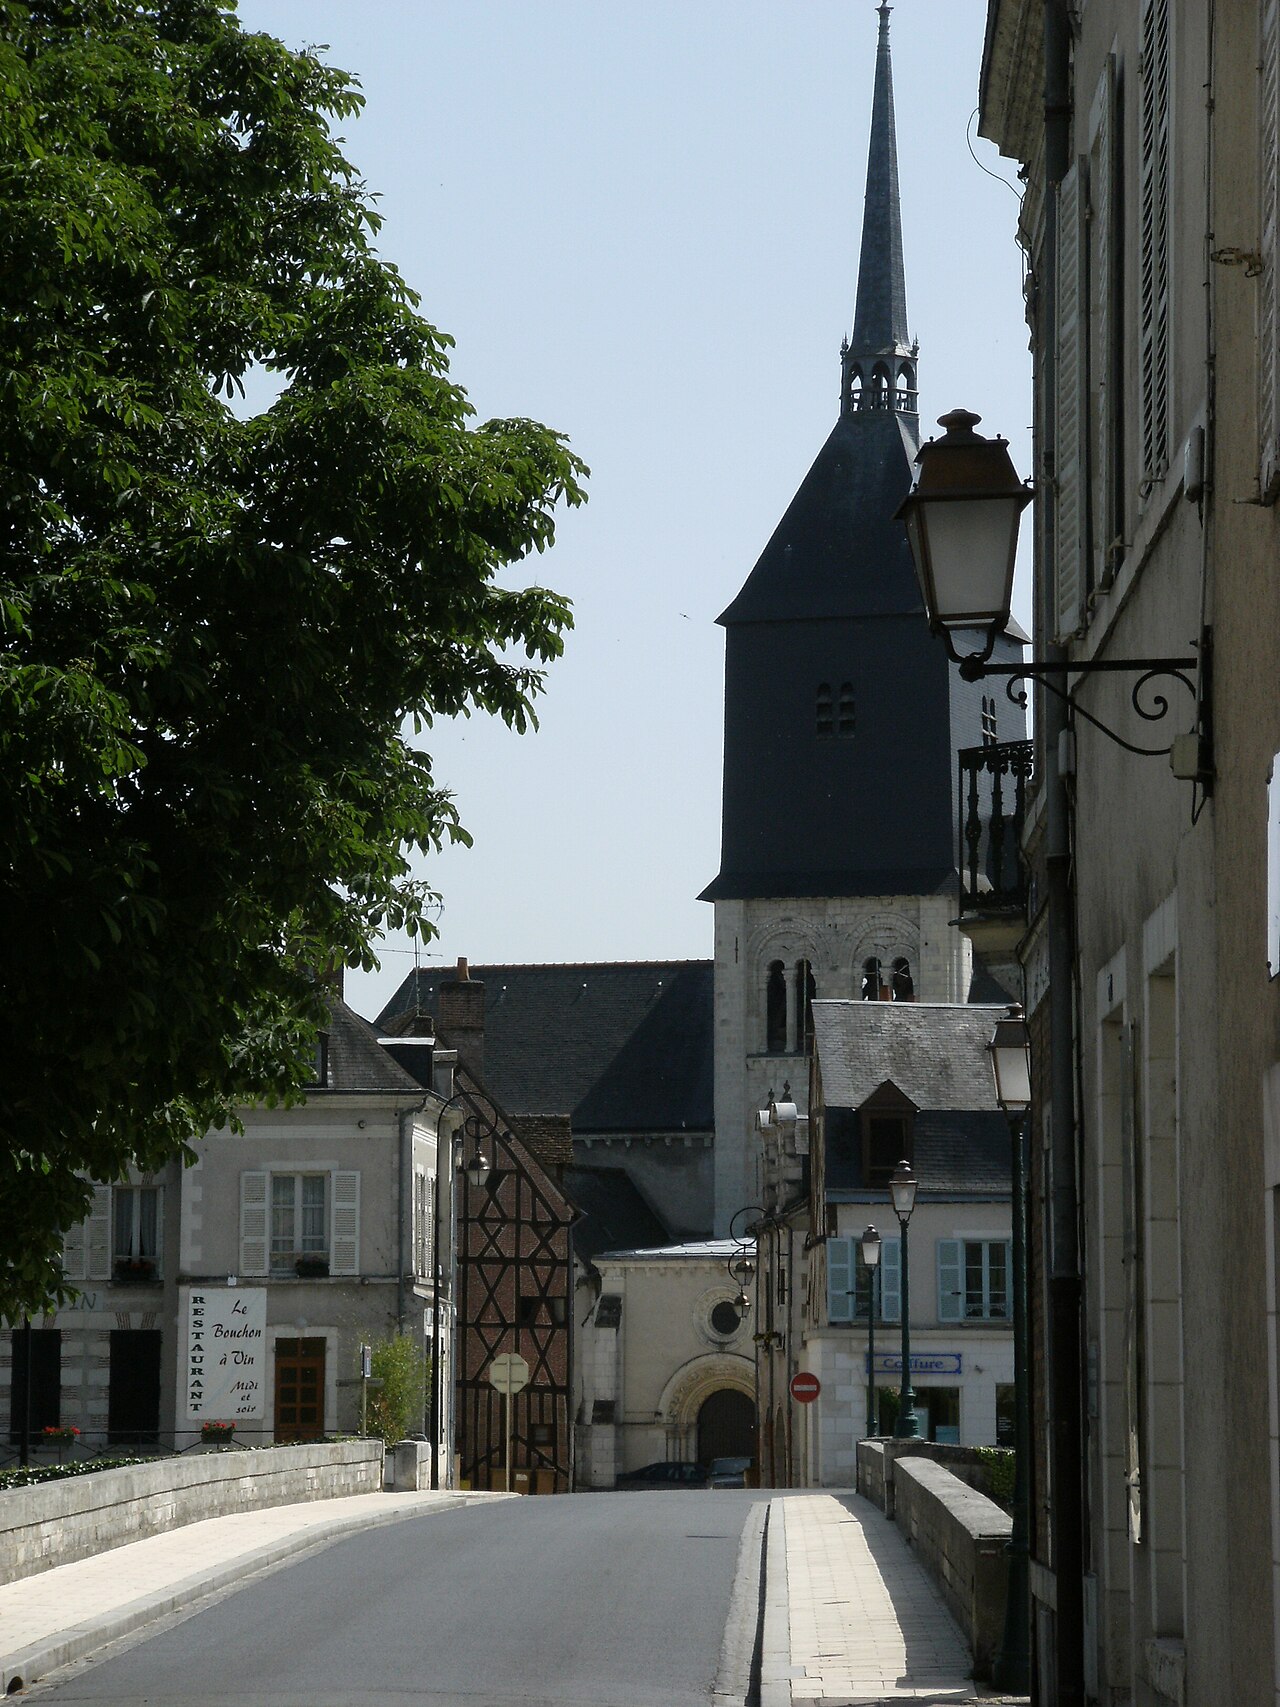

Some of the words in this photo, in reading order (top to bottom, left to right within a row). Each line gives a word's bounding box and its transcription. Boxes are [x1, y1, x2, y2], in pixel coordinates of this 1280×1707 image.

[231, 1299, 248, 1315] Le
[211, 1323, 262, 1338] Bouchon
[190, 1296, 206, 1412] RESTAURANT
[219, 1353, 227, 1365] à
[231, 1350, 254, 1365] Vin
[883, 1358, 944, 1369] Coffure
[230, 1380, 259, 1394] Midi
[240, 1393, 251, 1401] et
[236, 1405, 256, 1414] soir
